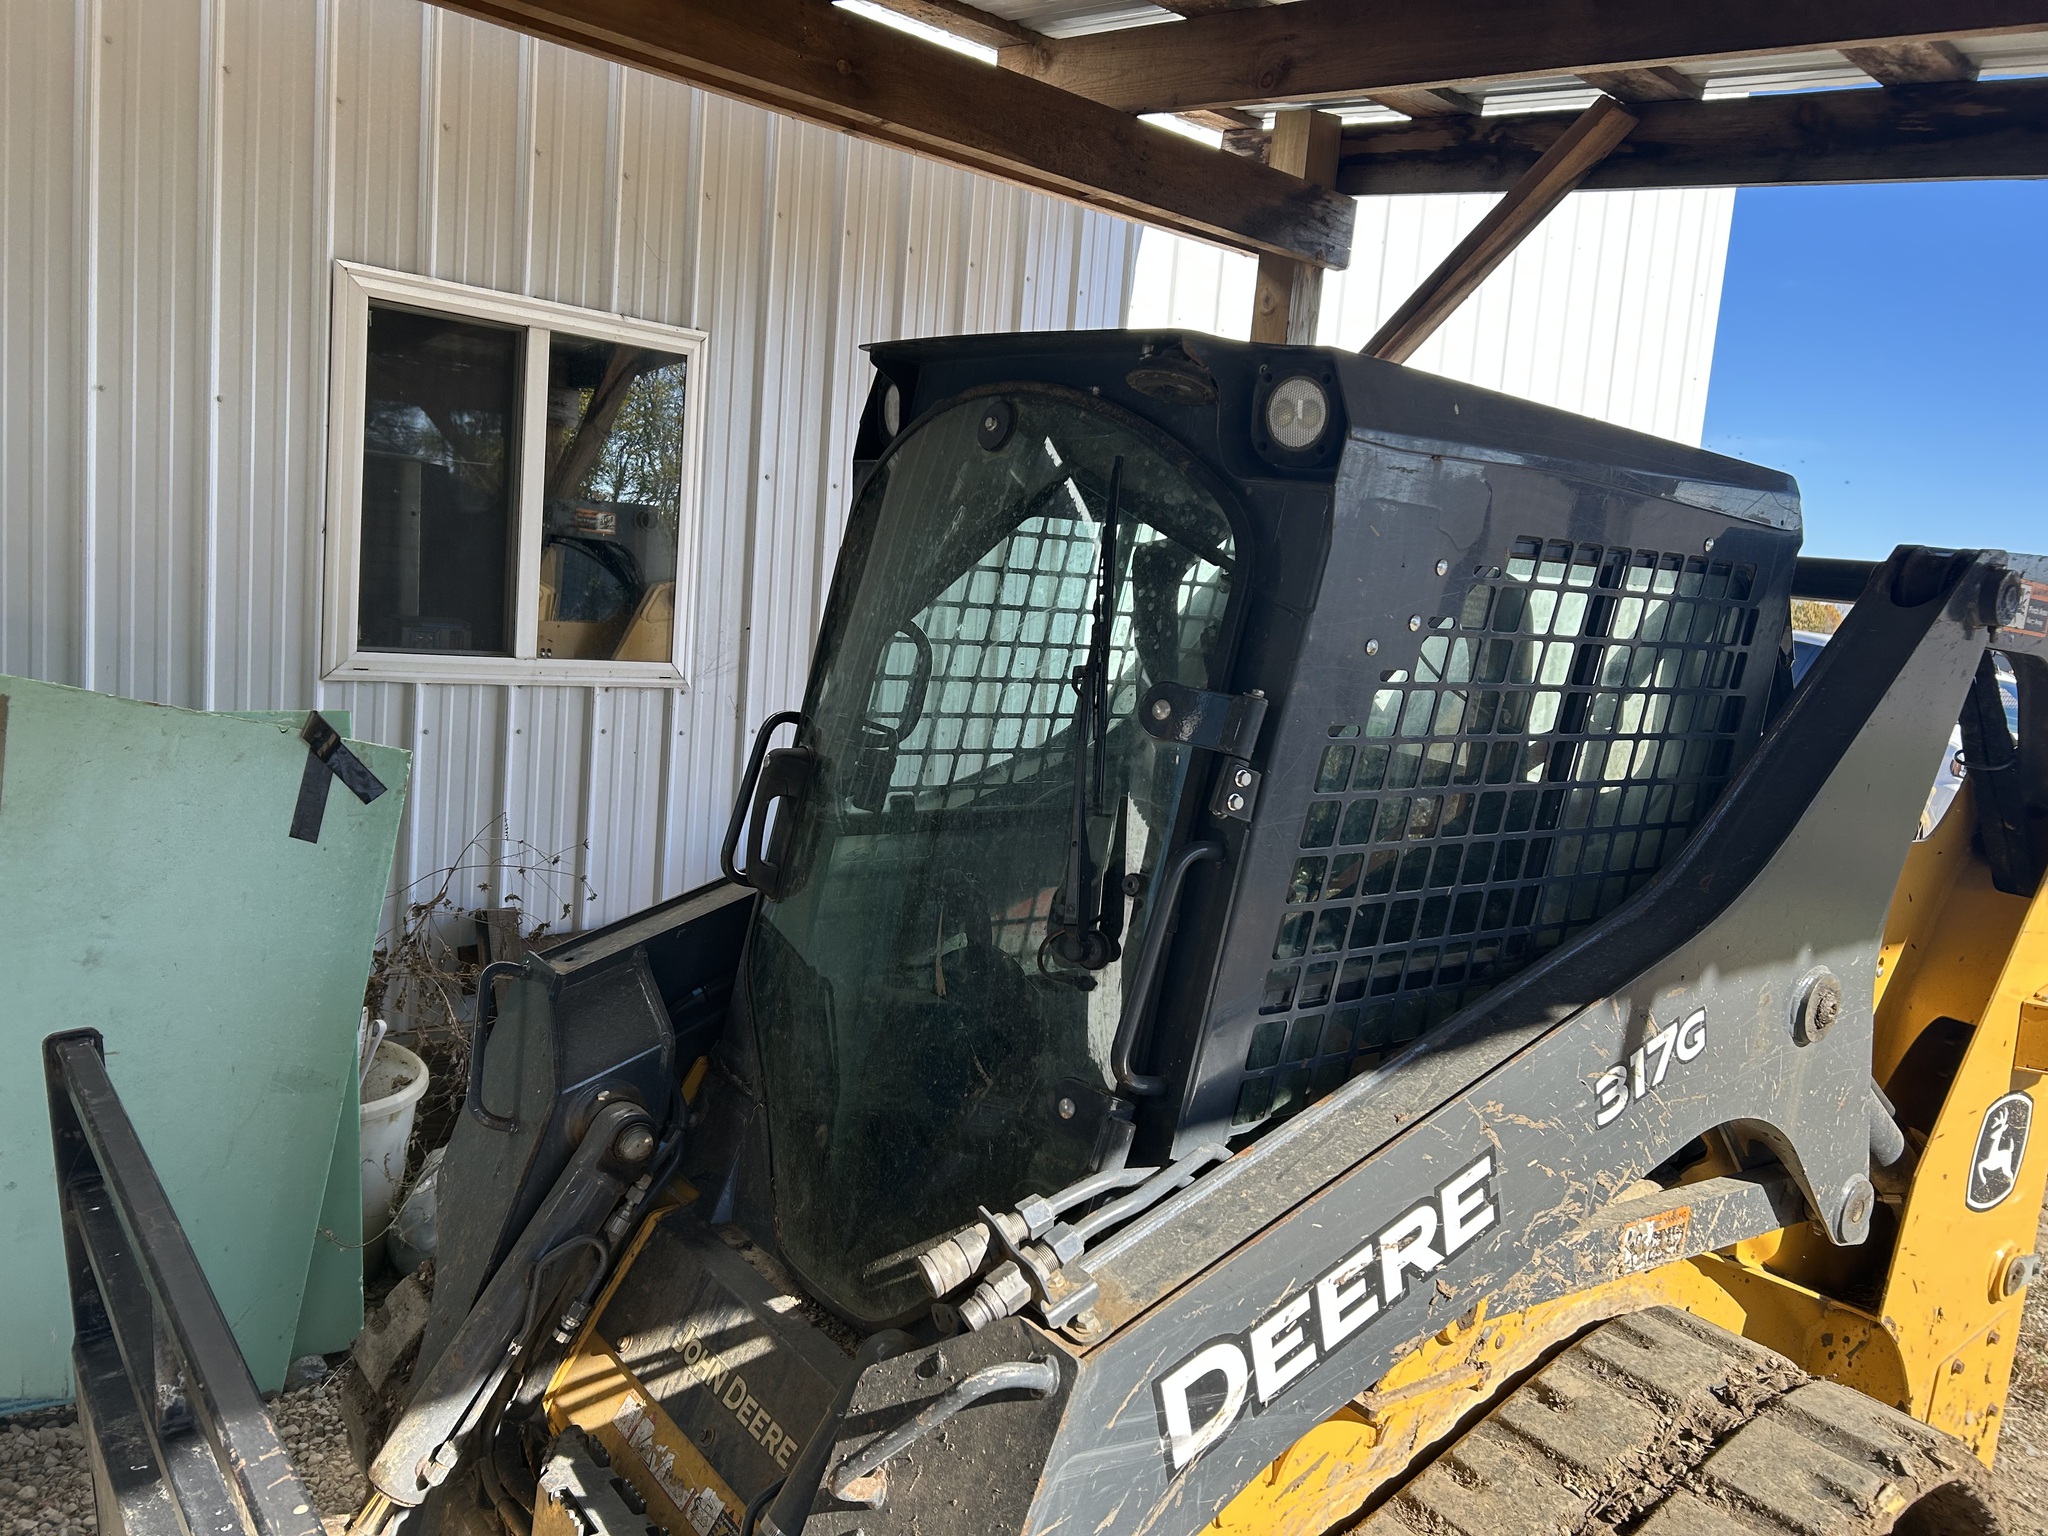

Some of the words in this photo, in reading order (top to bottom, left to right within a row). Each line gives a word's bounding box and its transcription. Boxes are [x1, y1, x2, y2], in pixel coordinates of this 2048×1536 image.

[1595, 1008, 1706, 1127] 317G
[1160, 1154, 1495, 1470] DEERE
[673, 1323, 731, 1395] JOHN
[721, 1375, 798, 1470] DEERE
